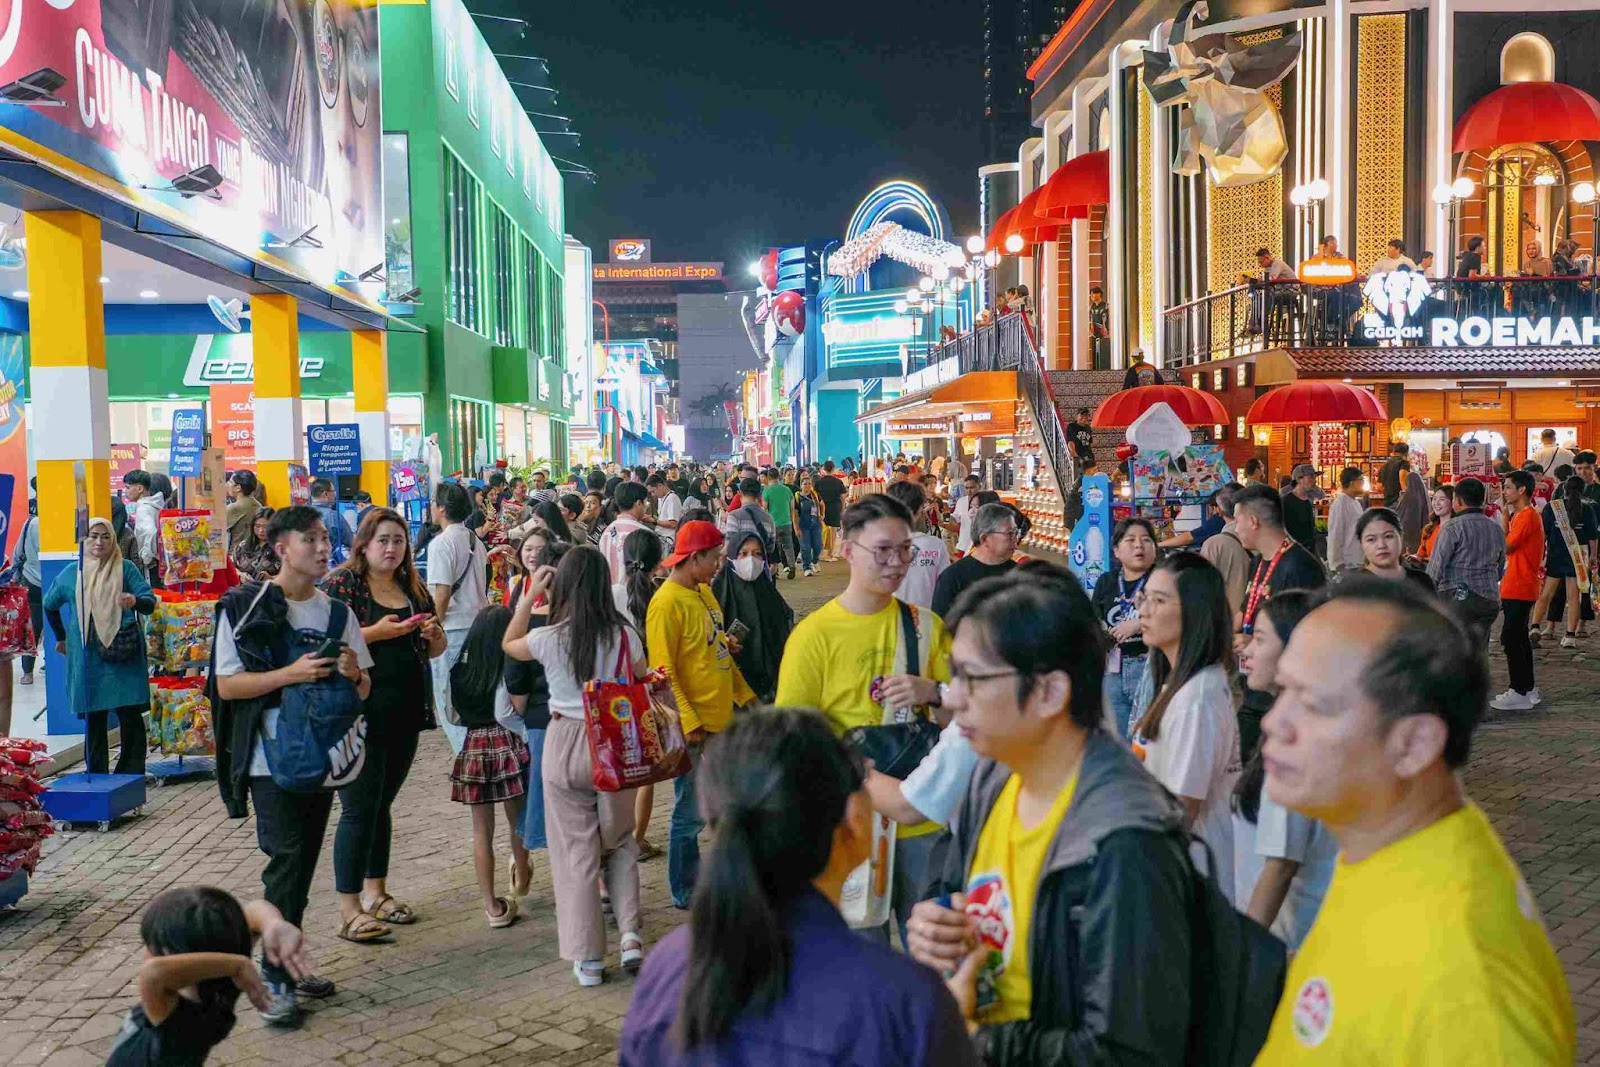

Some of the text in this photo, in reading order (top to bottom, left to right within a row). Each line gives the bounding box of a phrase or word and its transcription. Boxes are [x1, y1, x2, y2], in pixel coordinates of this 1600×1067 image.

[145, 67, 210, 171] TANGO
[608, 265, 682, 279] International
[685, 265, 717, 279] Expo
[1431, 316, 1600, 347] ROEMAH
[182, 334, 324, 386] Leae
[228, 430, 249, 440] BIG
[322, 444, 349, 452] Ringan
[318, 458, 351, 467] Nyaman
[174, 519, 199, 533] OOPS
[918, 550, 939, 558] ANGI
[920, 559, 935, 567] SPA
